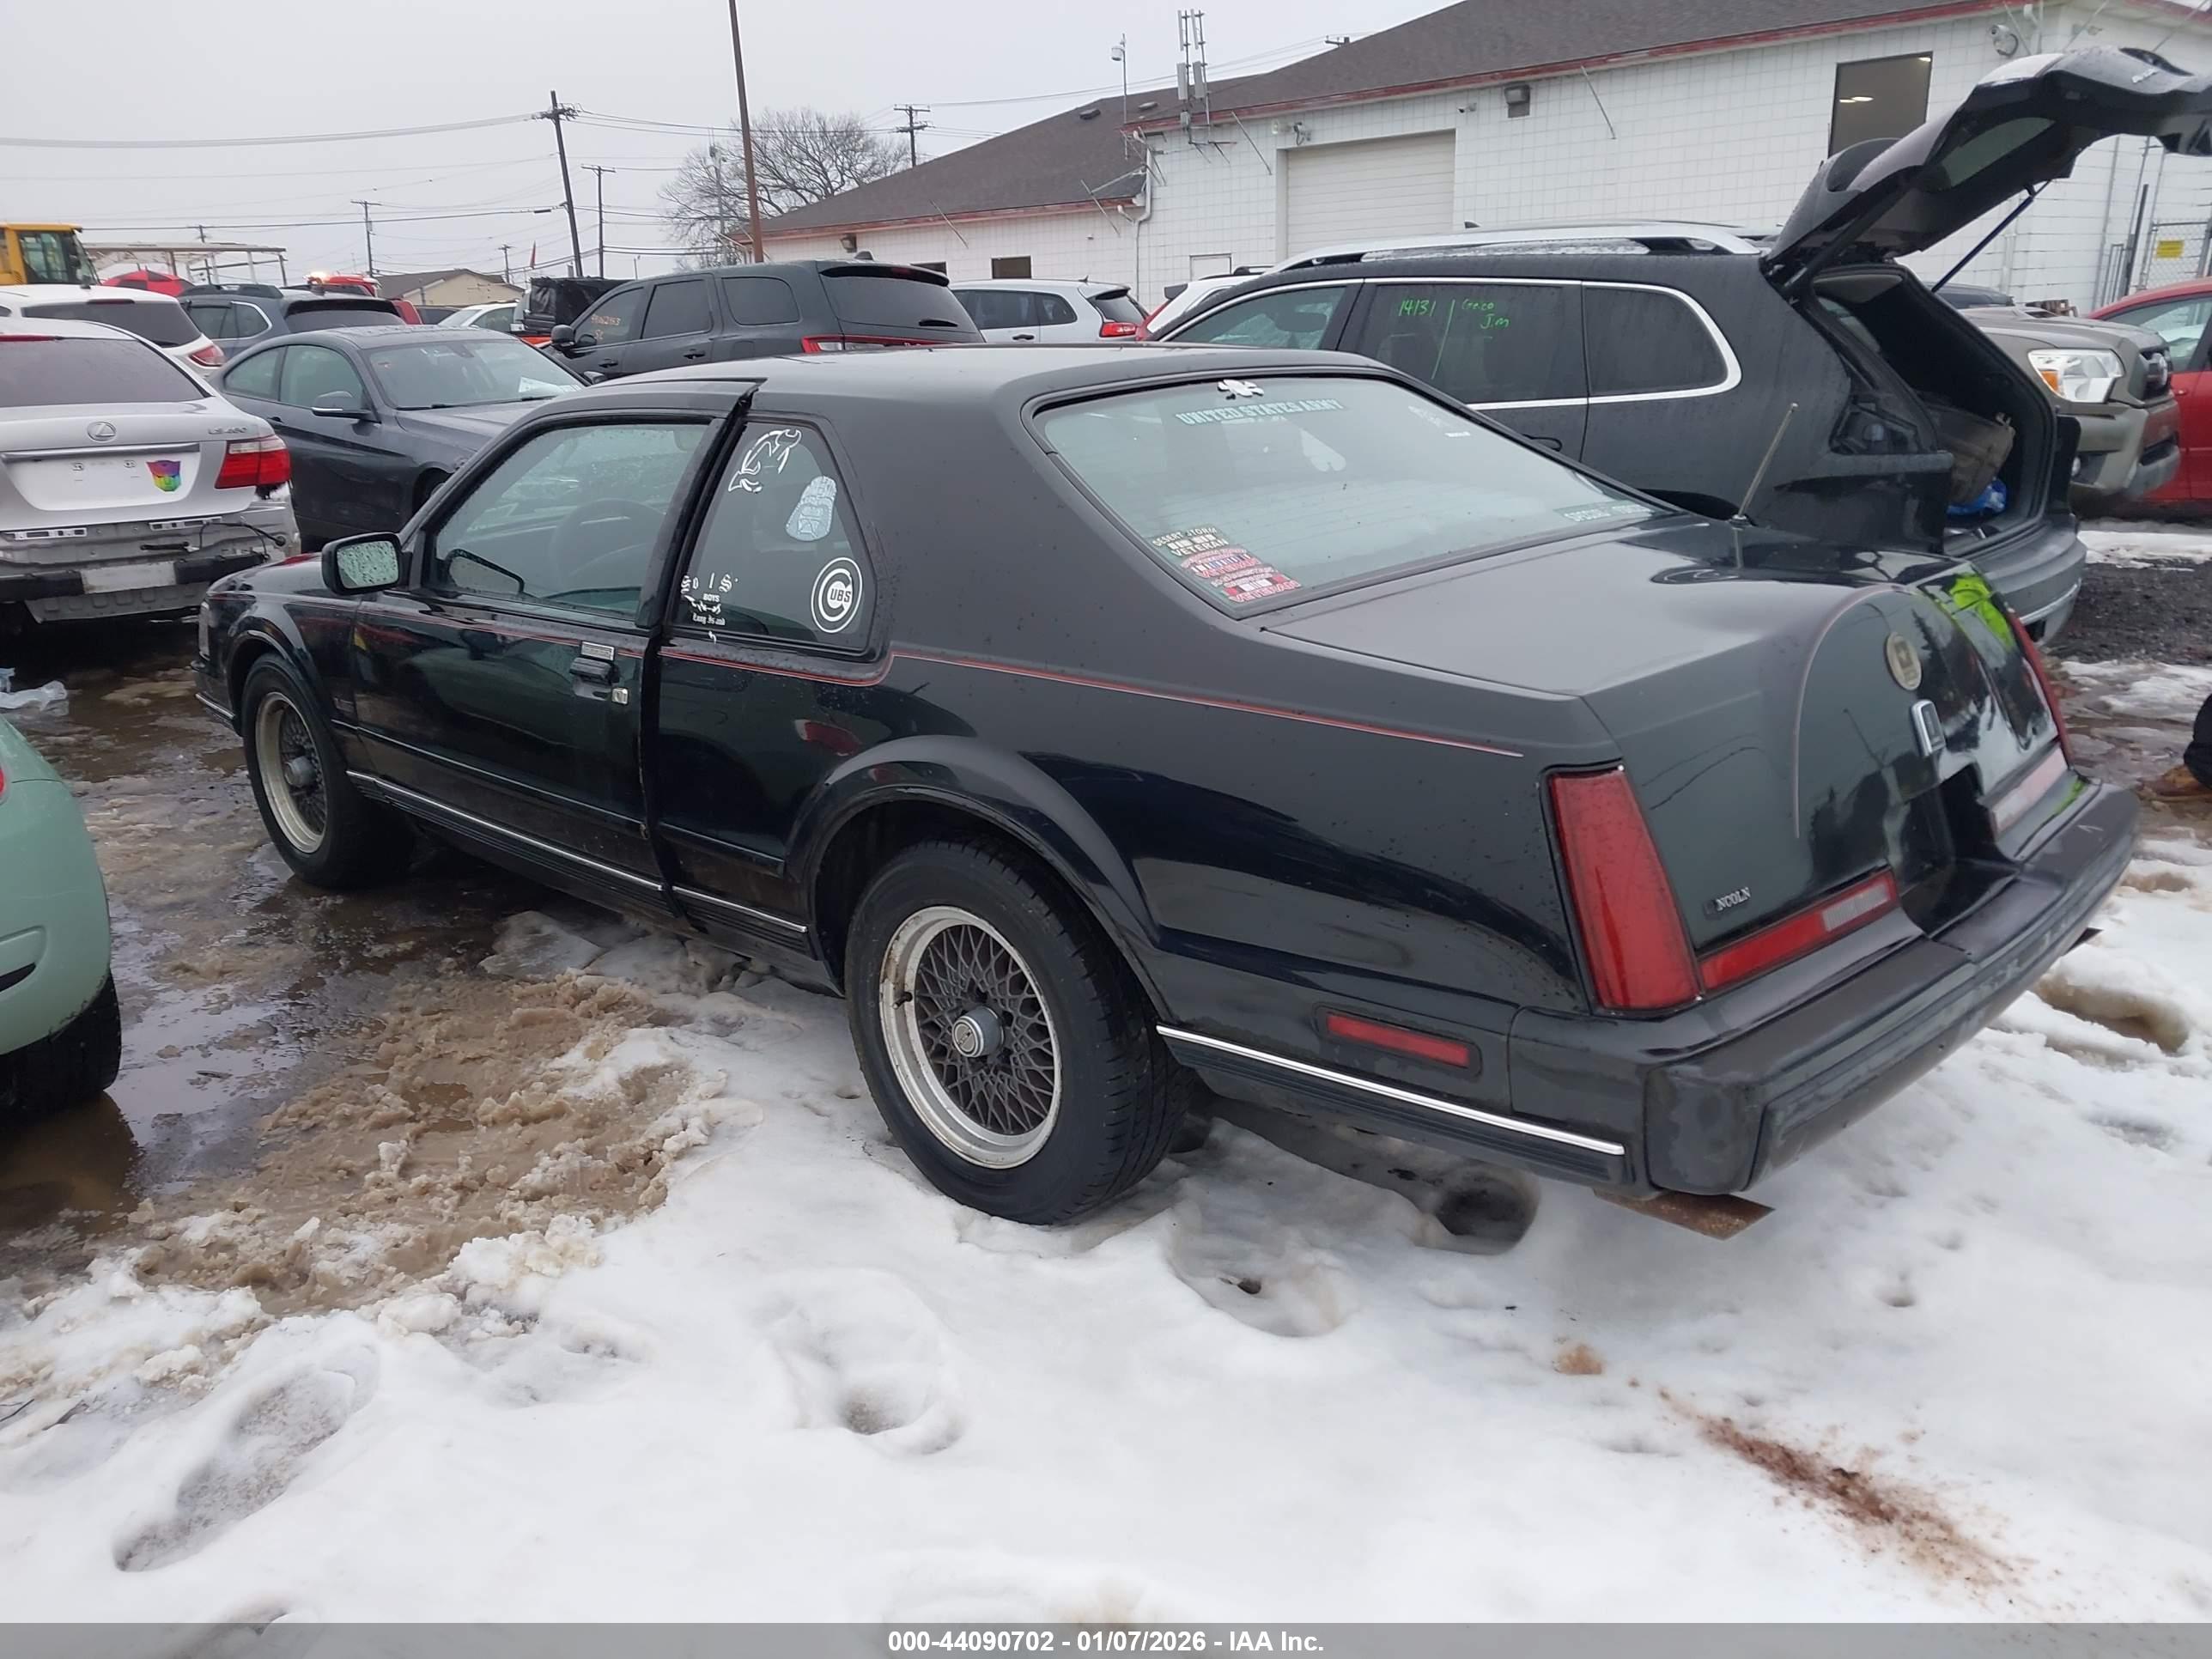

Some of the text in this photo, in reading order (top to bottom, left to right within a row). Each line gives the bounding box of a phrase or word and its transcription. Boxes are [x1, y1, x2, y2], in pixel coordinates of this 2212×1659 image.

[1398, 300, 1437, 317] 14131
[1175, 398, 1345, 425] UNITED STATES ARMY
[1152, 532, 1184, 547] DESERT
[1171, 538, 1230, 557] VETERAN
[703, 593, 720, 603] BOYS
[1706, 887, 1751, 912] NCOLN
